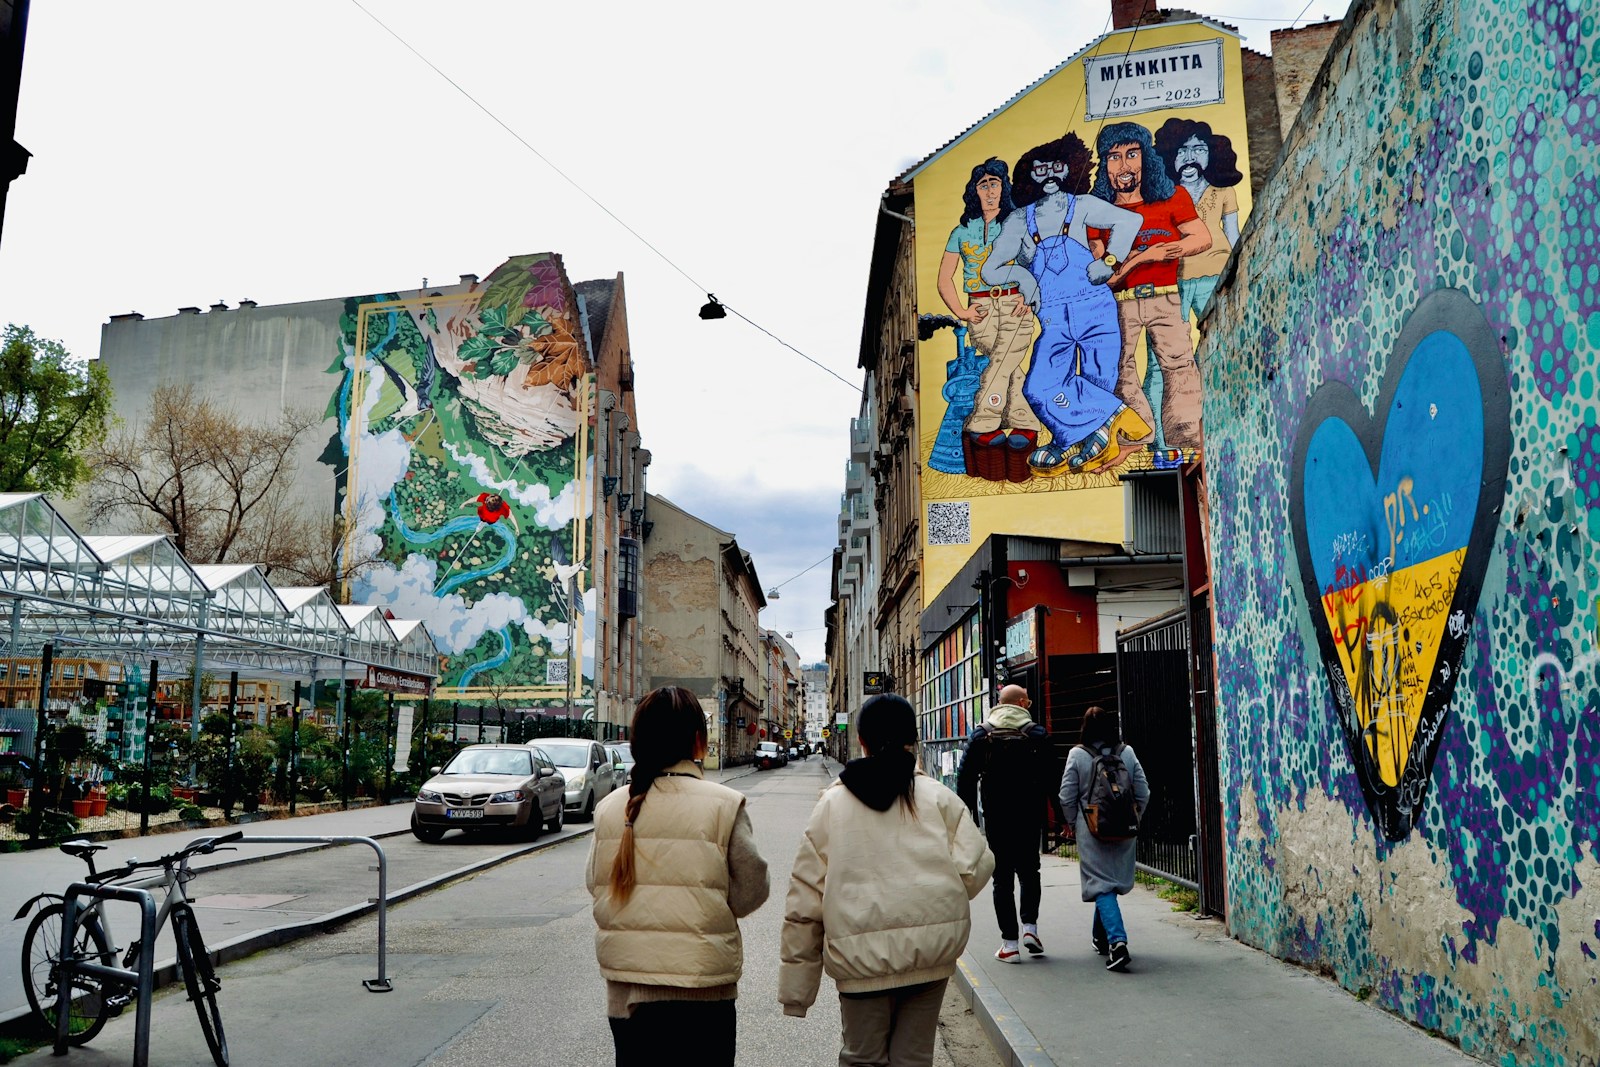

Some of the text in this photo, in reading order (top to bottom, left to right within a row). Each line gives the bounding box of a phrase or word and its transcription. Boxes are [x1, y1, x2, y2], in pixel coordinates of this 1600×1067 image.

[1101, 54, 1203, 82] MIÉNKITTA
[1140, 79, 1165, 91] TÉR
[1107, 87, 1201, 110] 1973 2023
